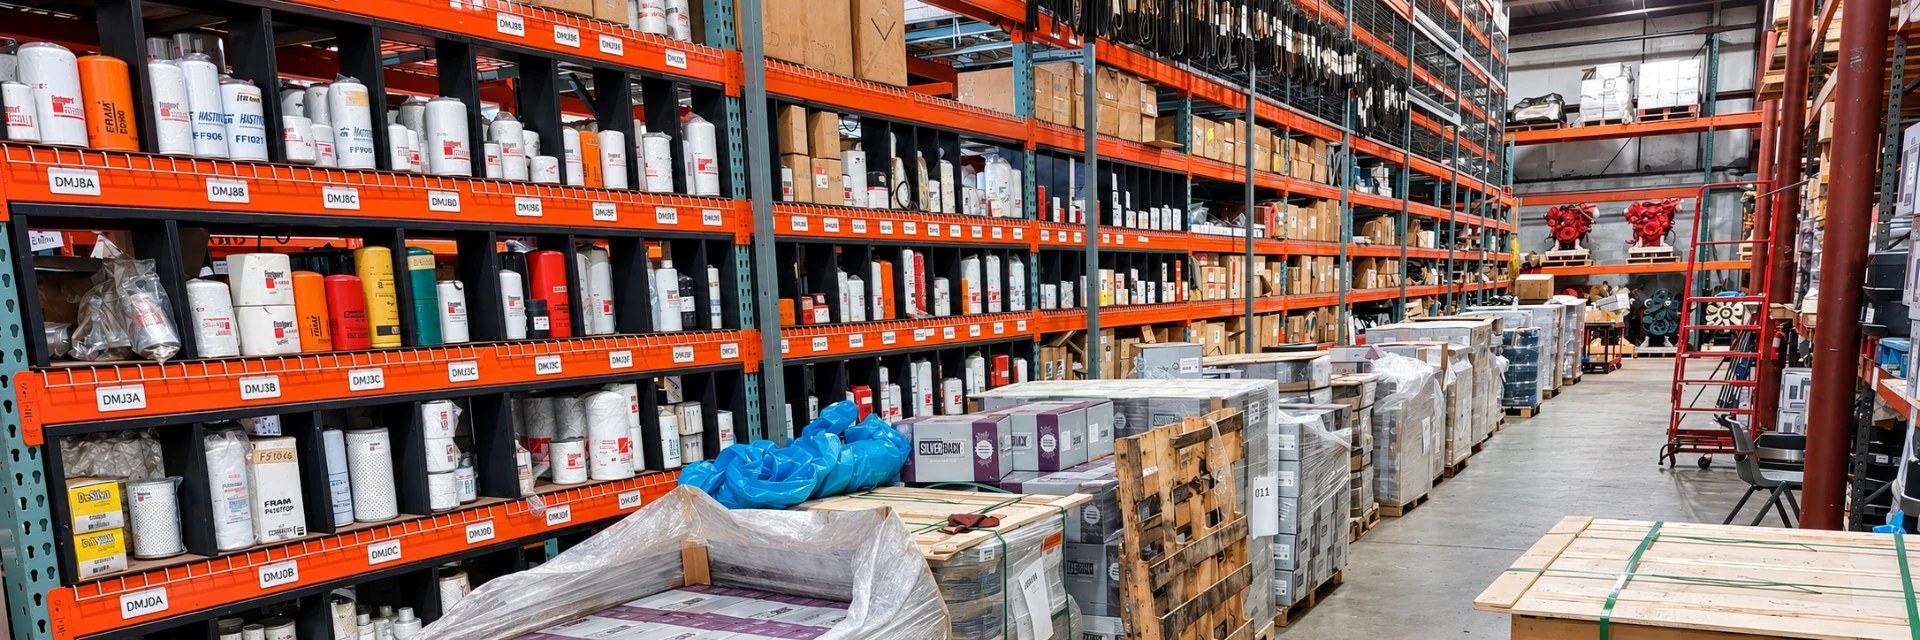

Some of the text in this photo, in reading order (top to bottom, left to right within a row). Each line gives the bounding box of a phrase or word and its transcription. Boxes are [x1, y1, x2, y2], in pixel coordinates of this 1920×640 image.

[353, 375, 381, 386] DMJ3C
[245, 383, 276, 394] DMJ3B
[103, 393, 140, 405] DMJ3A
[1254, 487, 1269, 498] 011
[264, 498, 292, 508] FRAM
